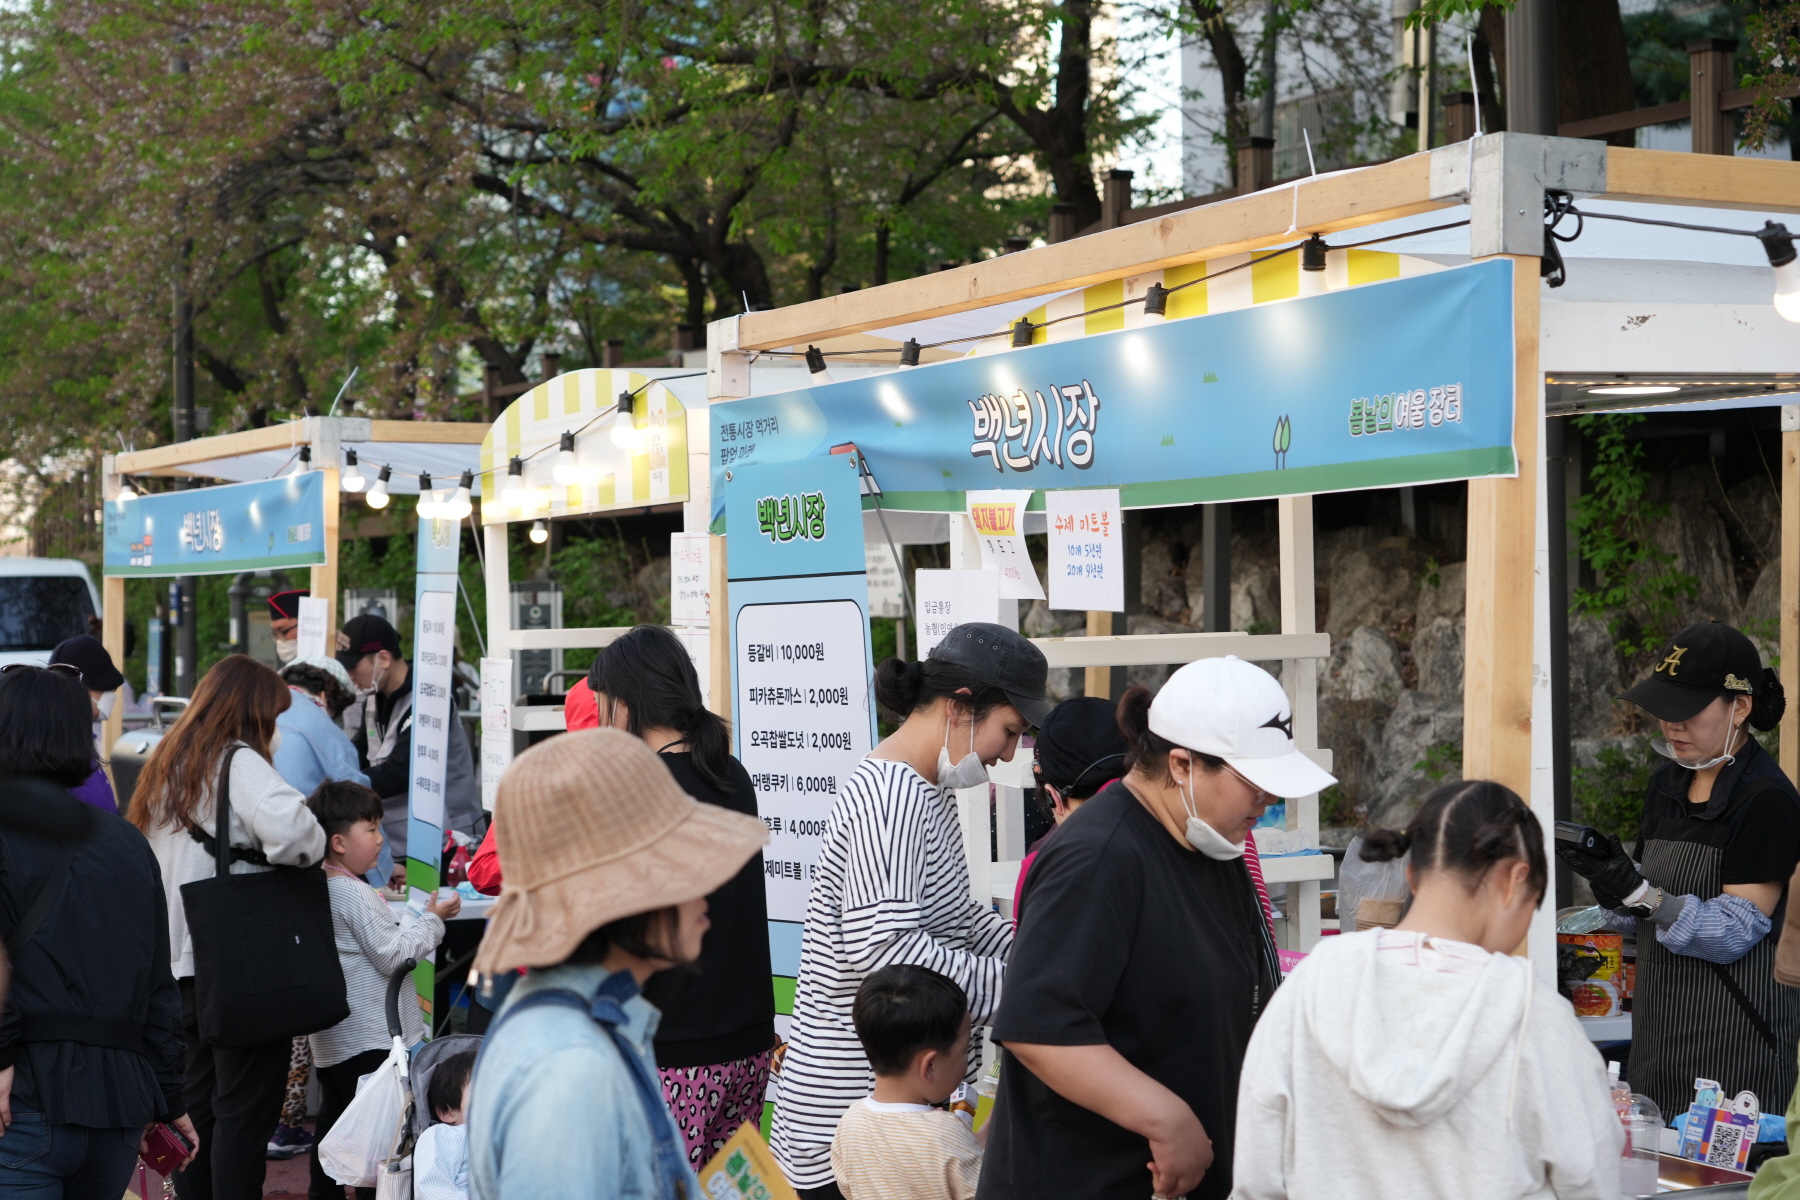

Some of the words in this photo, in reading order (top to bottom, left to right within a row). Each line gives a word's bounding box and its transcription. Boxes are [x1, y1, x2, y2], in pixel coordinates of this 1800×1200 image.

[720, 420, 754, 442] 전통시장
[755, 415, 779, 437] 먹거리
[968, 378, 1101, 473] 백년시장
[720, 444, 738, 465] 팝업
[757, 491, 826, 543] 백년시장
[1055, 513, 1074, 535] 수제
[1080, 511, 1110, 537] 미트볼
[183, 508, 221, 553] 백년시장
[1067, 544, 1082, 556] 10개
[1085, 543, 1102, 559] 5천원
[1067, 563, 1083, 576] 20개
[1086, 563, 1103, 579] 9천원
[925, 601, 951, 614] 입금통장
[748, 643, 774, 662] 등갈비
[781, 642, 824, 664] 10,000원
[1655, 645, 1688, 676] A
[749, 686, 802, 706] 피카츄돈까스
[809, 686, 849, 708] 2,000원
[751, 730, 804, 749] 오곡찹쌀도넛
[811, 731, 852, 752] 2,000원
[752, 773, 789, 792] 머랭쿠키
[796, 776, 837, 795] 6,000원
